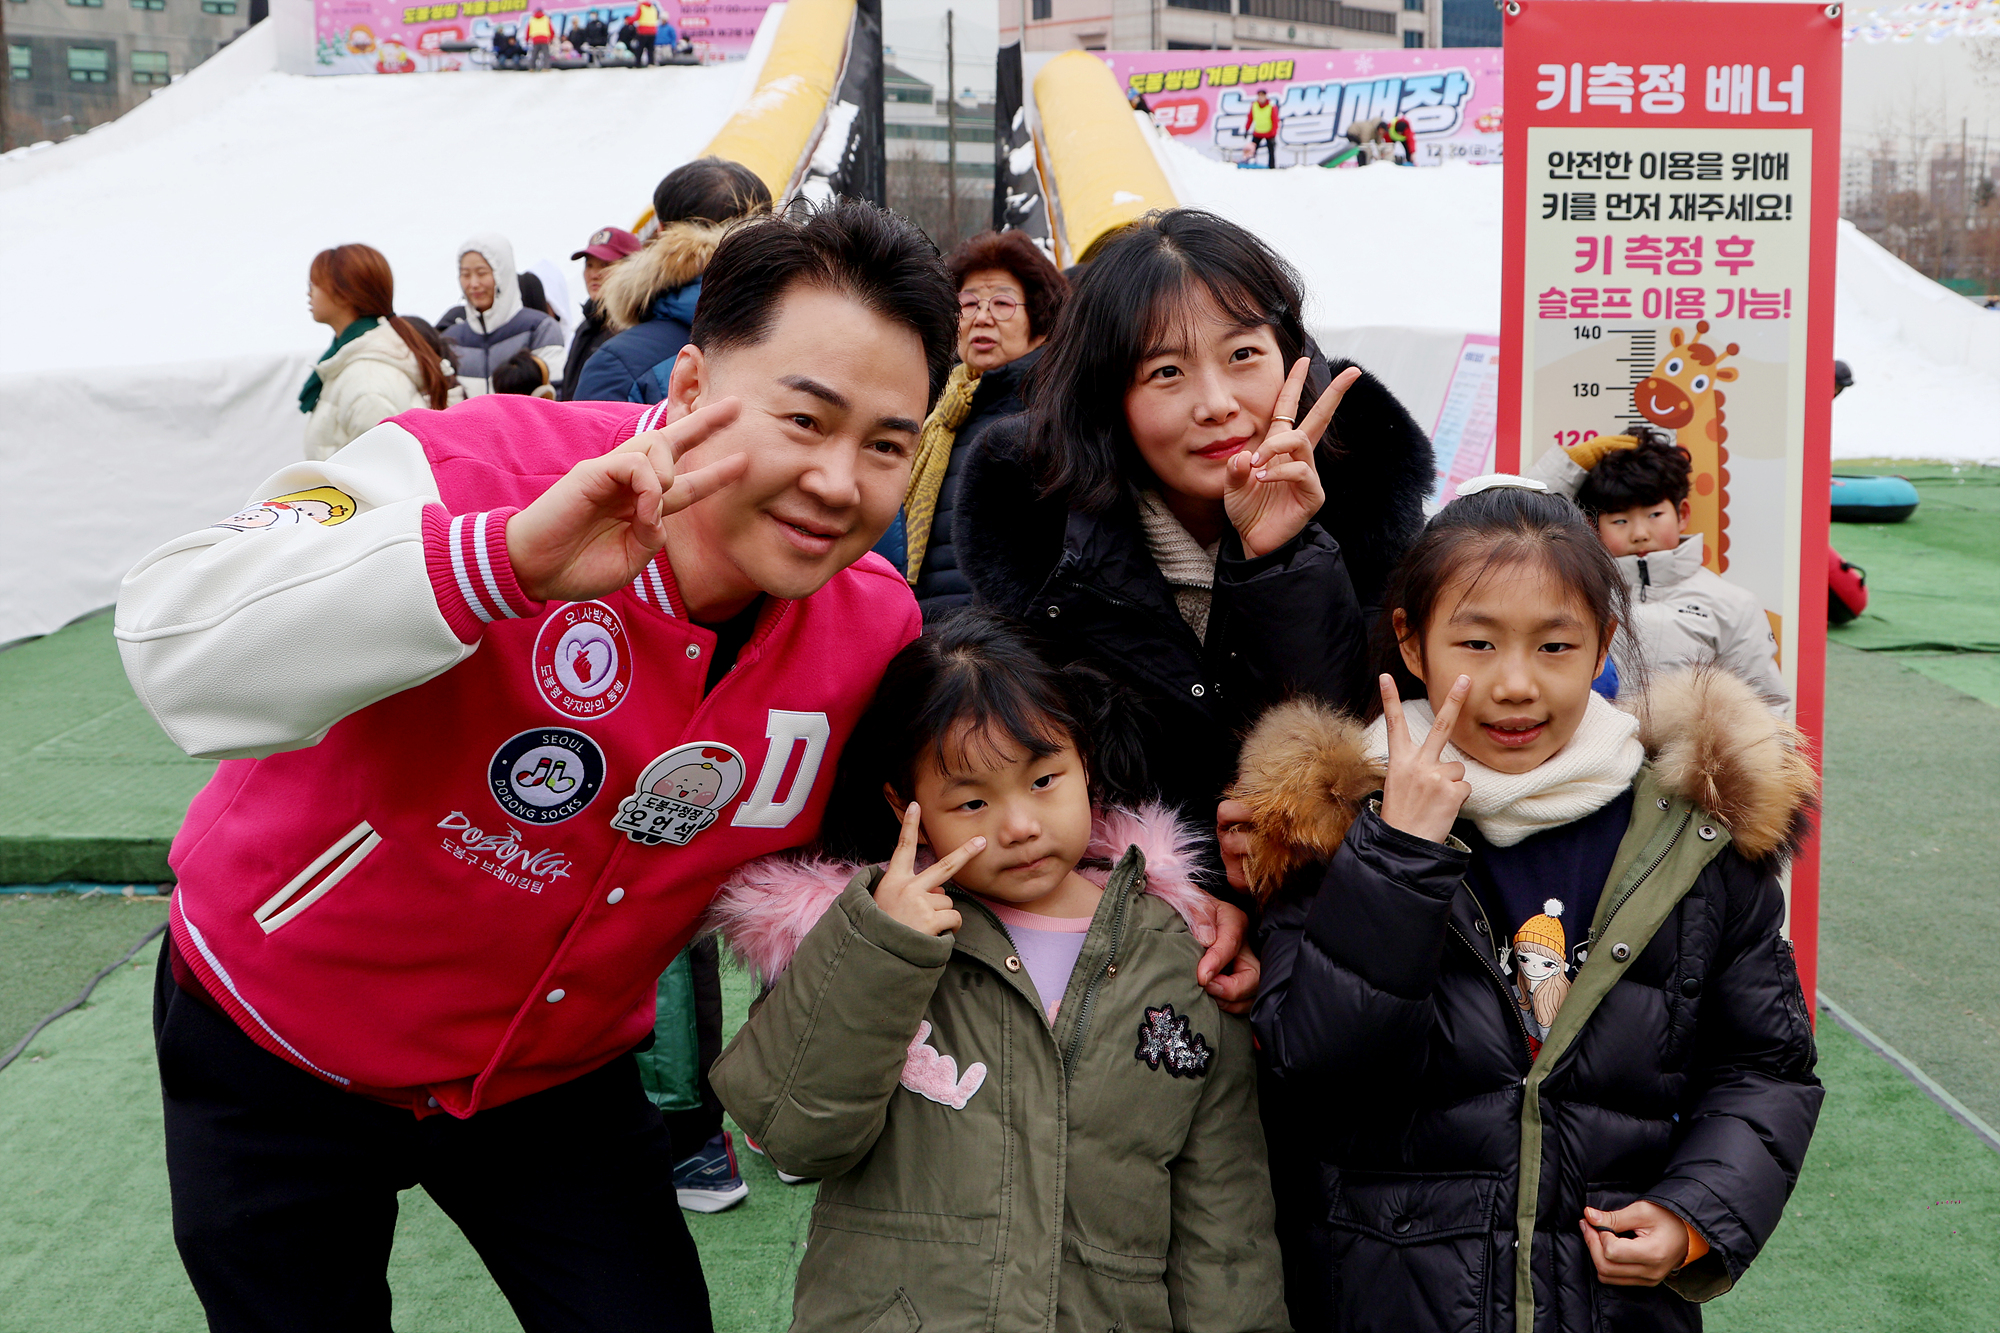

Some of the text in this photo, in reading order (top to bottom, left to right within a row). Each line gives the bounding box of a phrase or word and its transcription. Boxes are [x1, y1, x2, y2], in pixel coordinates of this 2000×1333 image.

[1536, 62, 1804, 115] 키측정 배너
[1154, 103, 1200, 129] 무료
[1548, 151, 1789, 181] 안전한 이용을 위해
[1542, 192, 1792, 222] 키를 먼저 재주세요!
[1574, 234, 1755, 276] 키 측정 후
[1538, 286, 1792, 320] 슬로프 이용 가능!
[1574, 326, 1601, 340] 140
[1573, 383, 1600, 398] 130
[562, 696, 605, 713] 약자와의
[542, 734, 585, 754] SEOUL
[730, 708, 831, 829] D
[494, 779, 583, 820] DOBONG SOCKS
[642, 797, 703, 821] 도봉구청장
[440, 837, 545, 894] 도봉구 브레이킹팀
